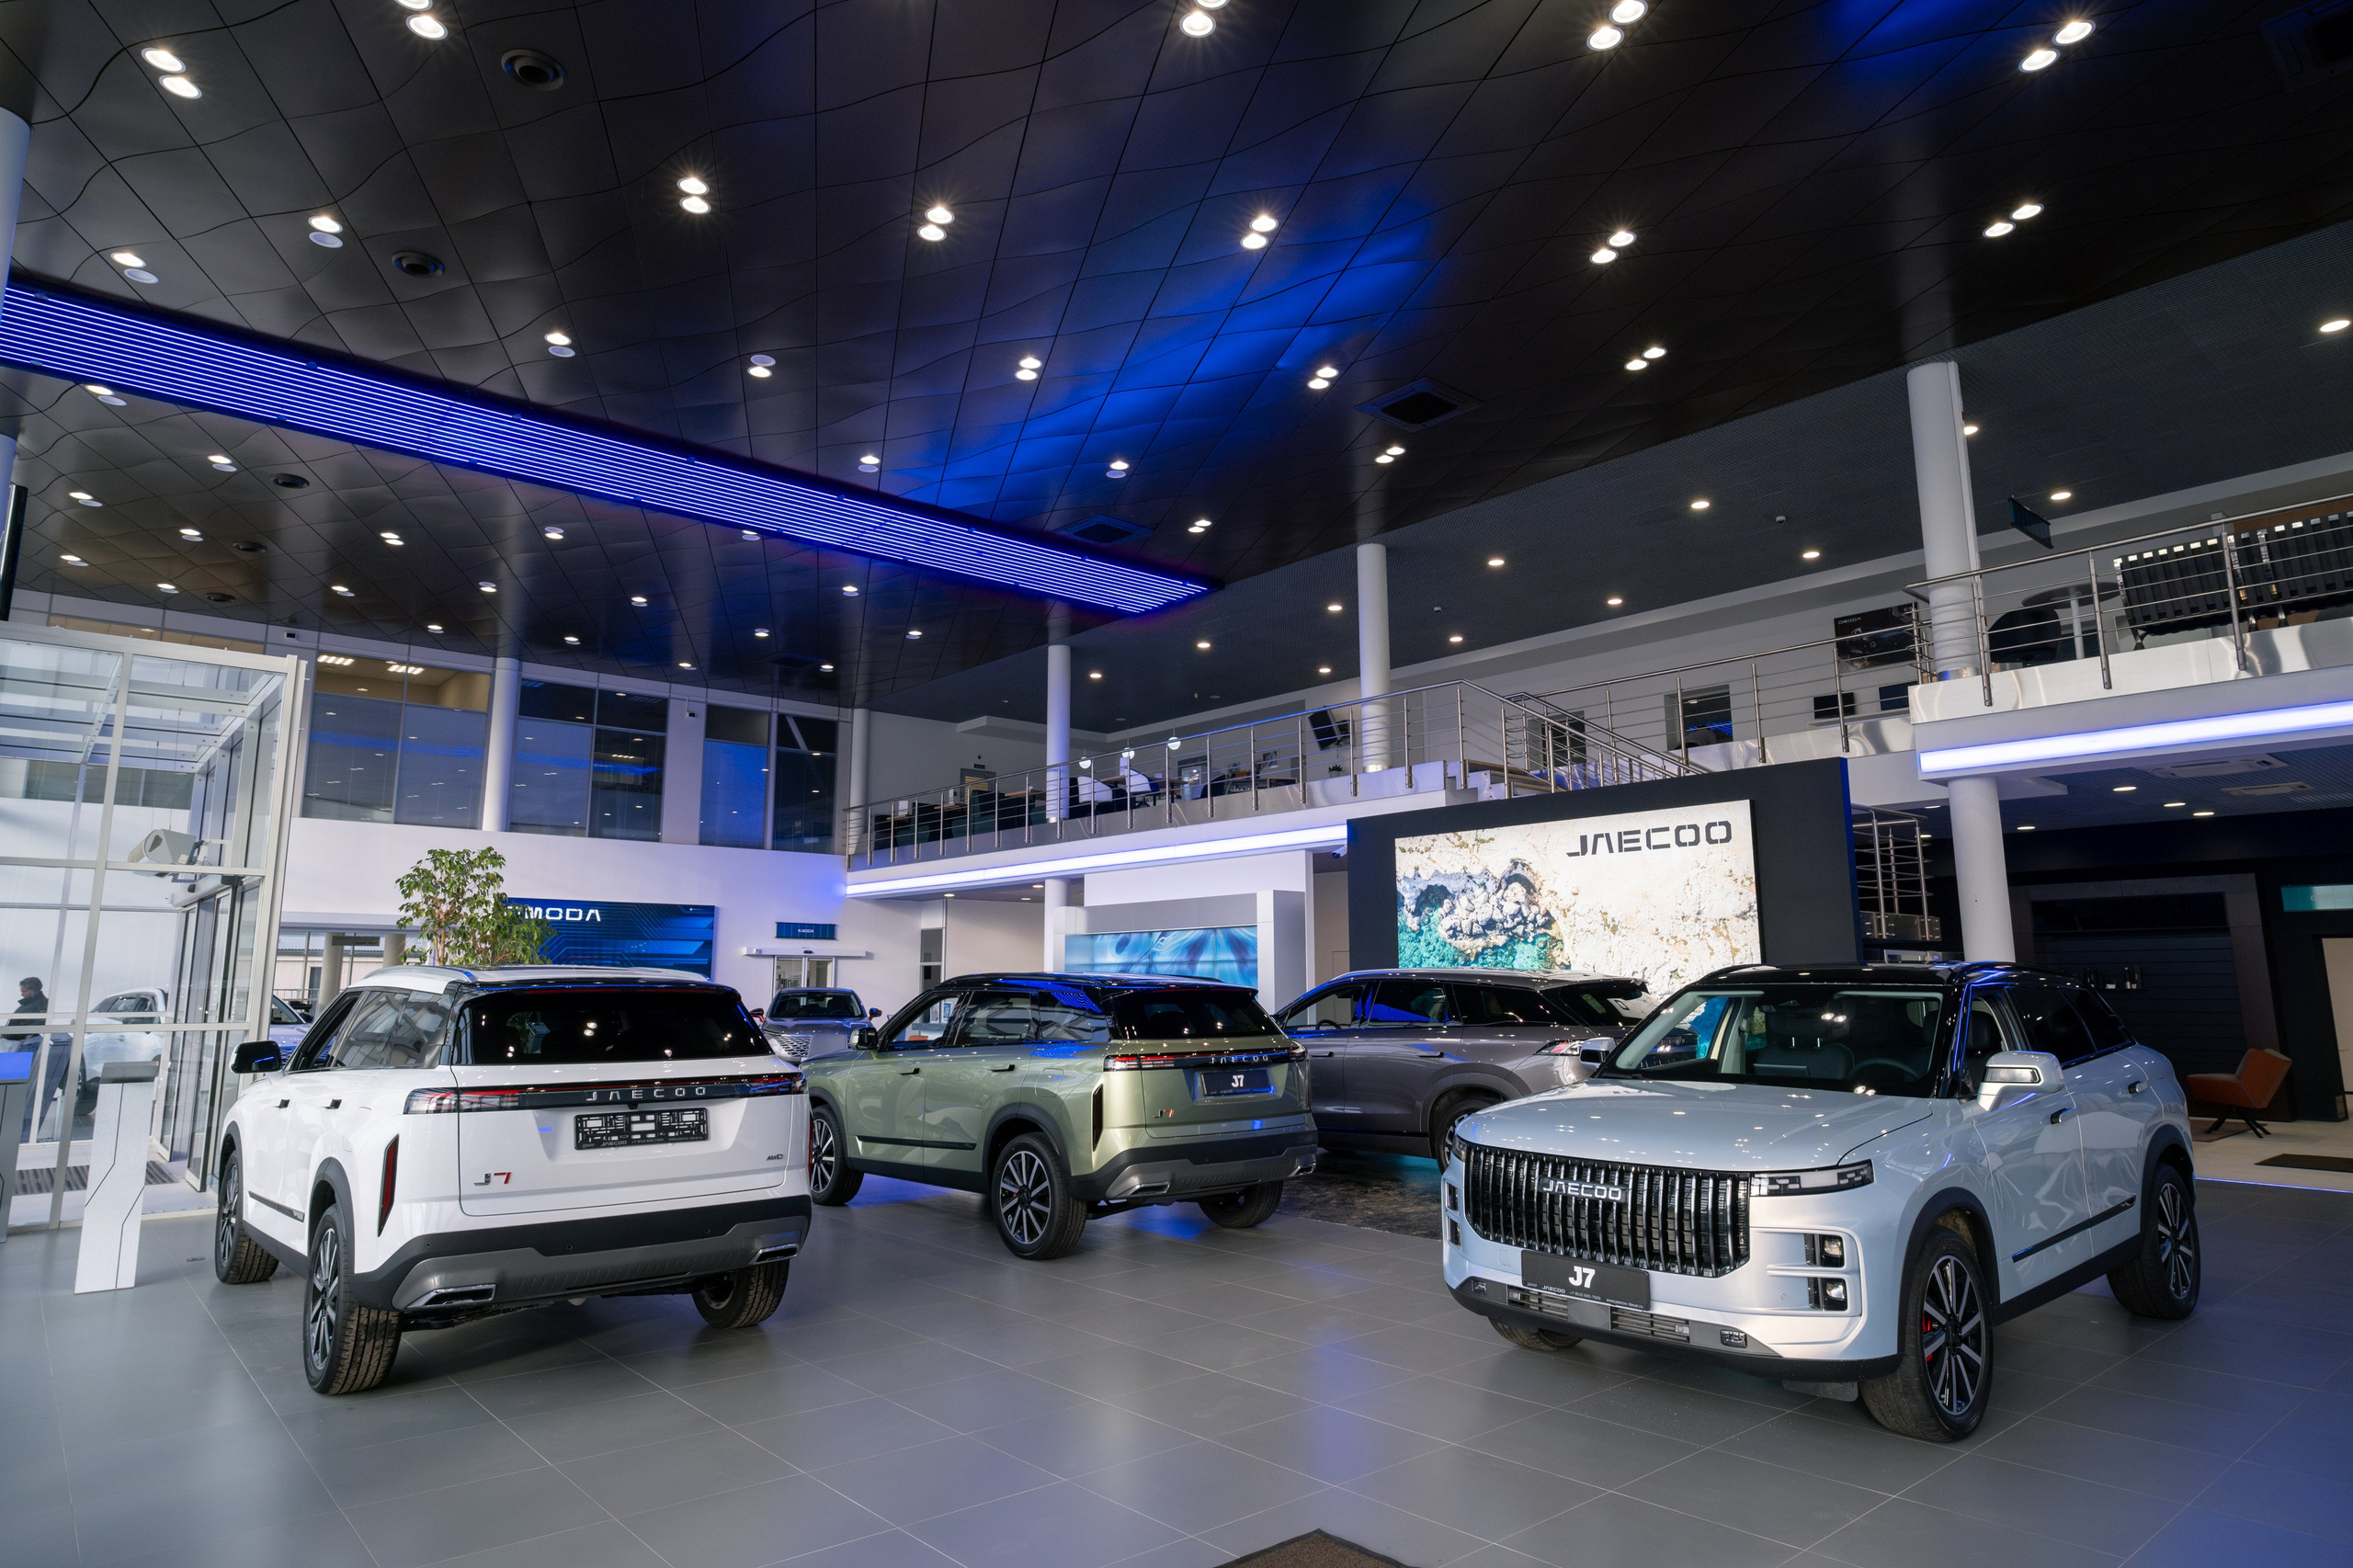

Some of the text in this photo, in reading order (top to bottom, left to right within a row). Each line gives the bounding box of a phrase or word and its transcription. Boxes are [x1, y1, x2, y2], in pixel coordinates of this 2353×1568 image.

[1565, 821, 1733, 858] JAECOO
[1231, 1074, 1245, 1087] J7
[585, 1086, 706, 1101] JAECOO
[473, 1172, 512, 1187] J7
[1543, 1180, 1622, 1200] JAECOO
[1568, 1265, 1596, 1289] J7
[1541, 1285, 1566, 1294] JAECOO
